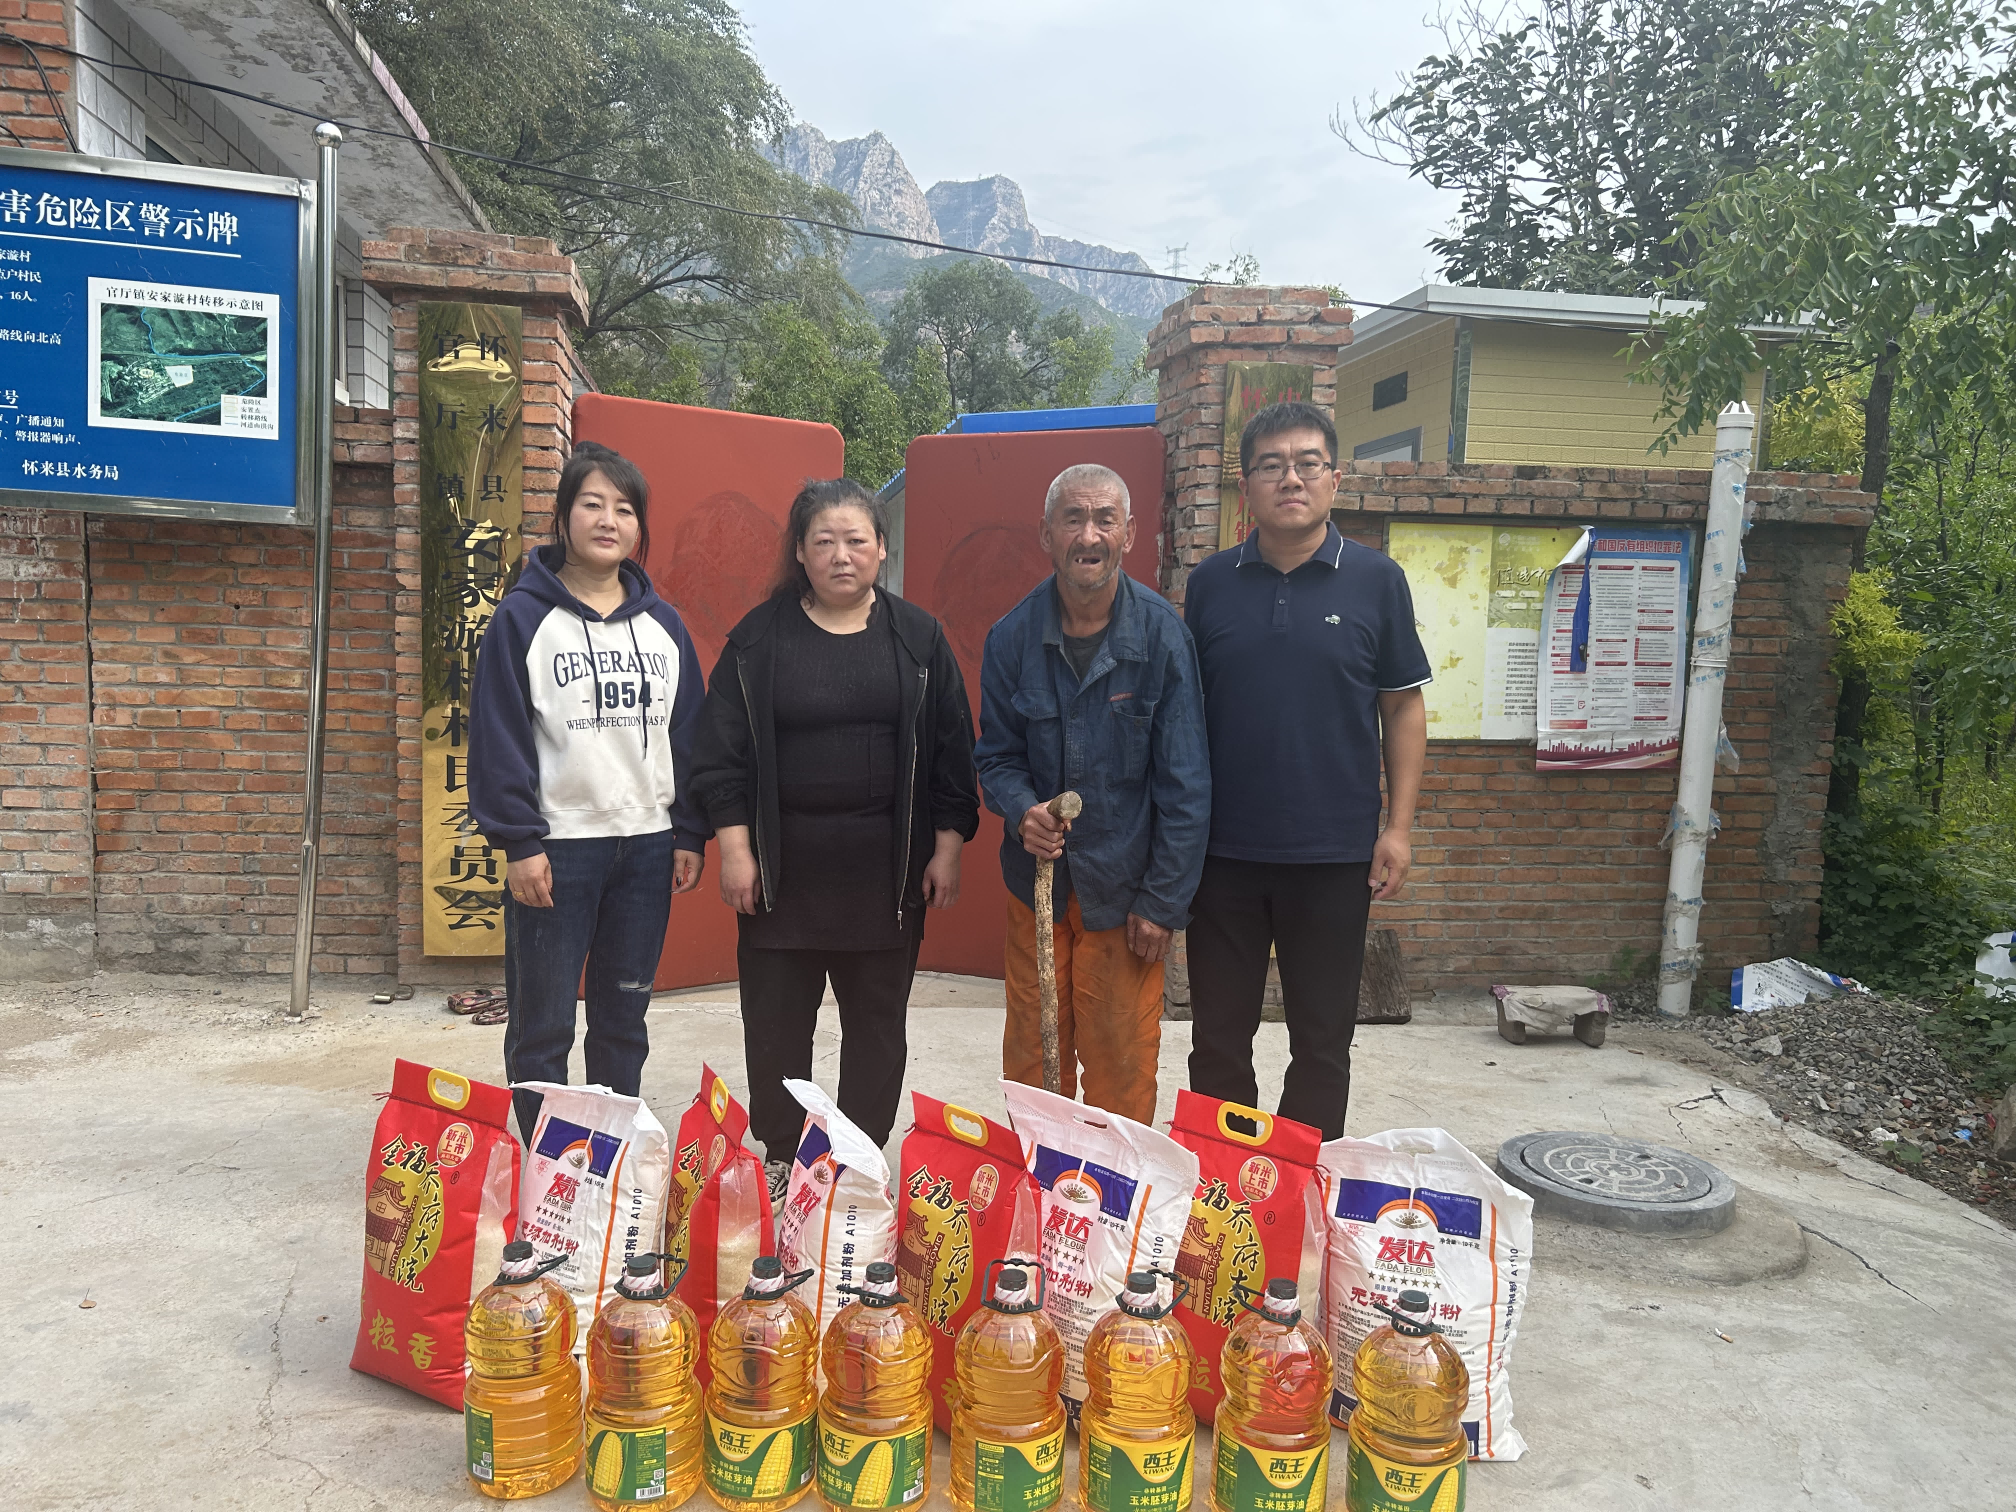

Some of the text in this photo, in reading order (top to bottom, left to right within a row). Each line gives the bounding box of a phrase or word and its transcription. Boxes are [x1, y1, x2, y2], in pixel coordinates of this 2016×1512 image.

[0, 189, 240, 246] 害危险区警示牌
[106, 286, 264, 312] 官厅镇安家漩村转移示意图
[0, 329, 62, 345] 路线向北高
[434, 329, 467, 502] 官厅镇
[476, 331, 508, 503] 怀来县
[22, 459, 119, 481] 怀来县水务局
[596, 681, 652, 709] 1954
[446, 1129, 469, 1144] 新米
[442, 1141, 466, 1155] 上市
[1248, 1161, 1272, 1179] 新米
[1245, 1174, 1269, 1190] 上市
[1045, 1204, 1094, 1245] 发达
[1059, 1236, 1086, 1253] FLOUR
[1151, 1236, 1164, 1267] A1010
[1376, 1236, 1436, 1268] 发达
[1403, 1264, 1436, 1276] FLOUR
[720, 1428, 752, 1449] 西王
[824, 1429, 851, 1455] 西王
[719, 1442, 750, 1455] XIWANG
[1143, 1448, 1177, 1469] 西王
[1269, 1456, 1305, 1474] 西王
[1142, 1465, 1175, 1475] XIWANG
[1268, 1472, 1303, 1480] XIWANG
[1384, 1466, 1423, 1488] 西王
[1384, 1481, 1421, 1494] XIWANG
[1128, 1491, 1178, 1506] 玉米胚芽油
[1254, 1498, 1305, 1512] 玉米胚芽油
